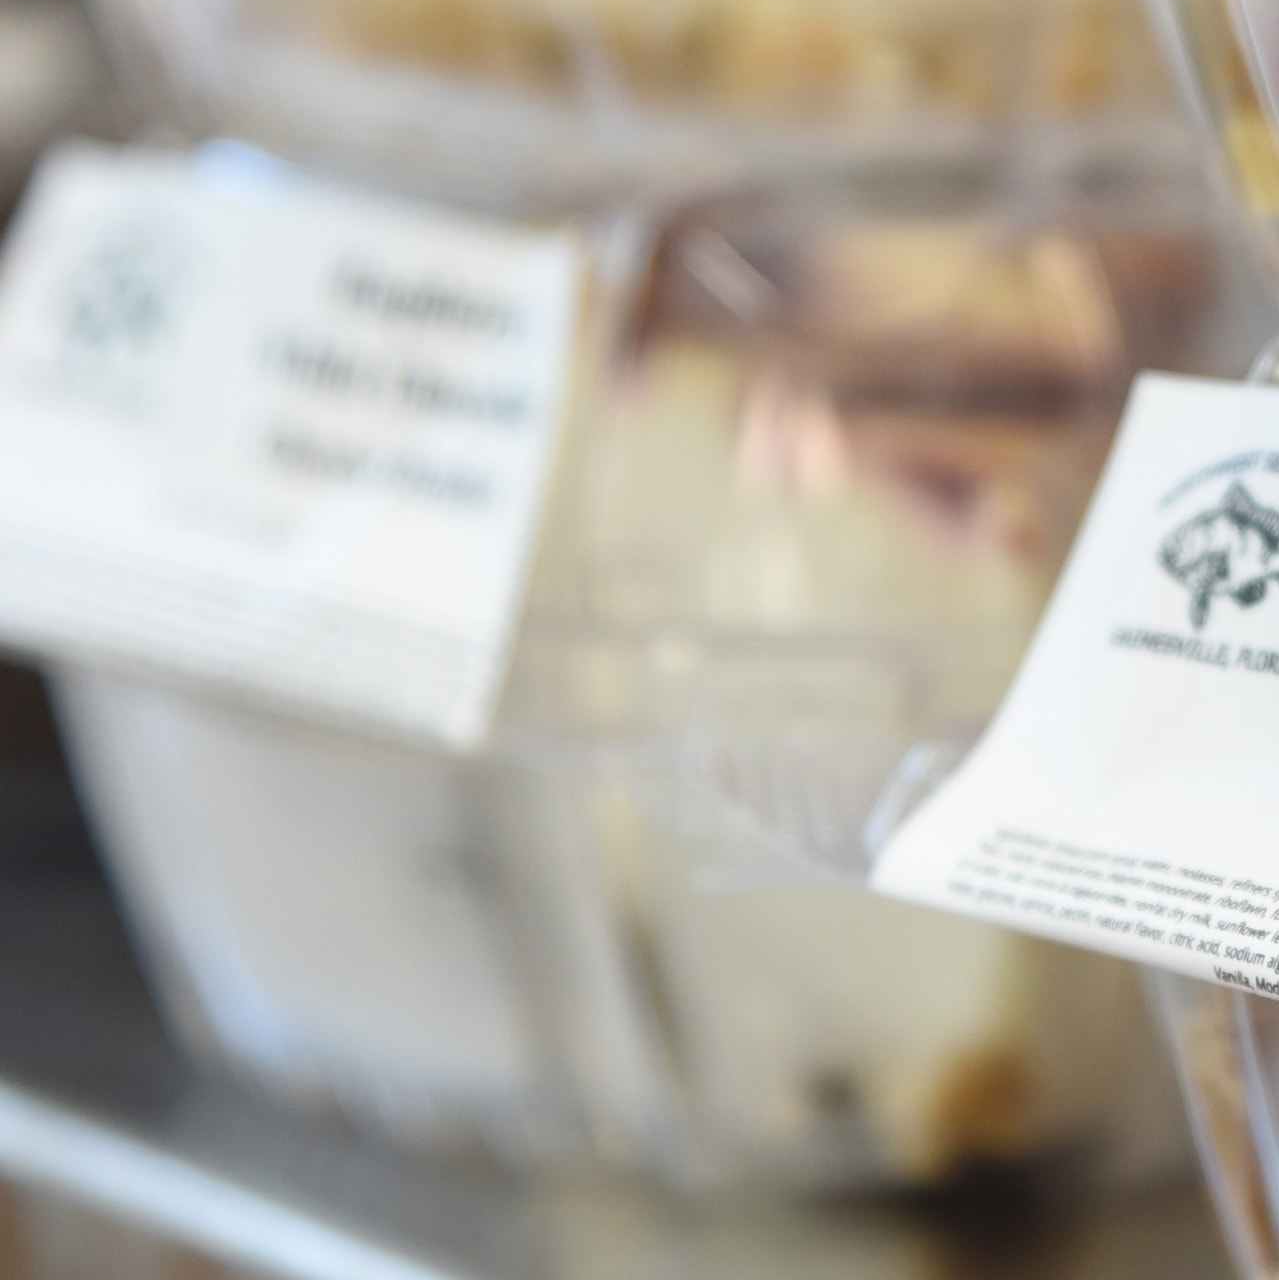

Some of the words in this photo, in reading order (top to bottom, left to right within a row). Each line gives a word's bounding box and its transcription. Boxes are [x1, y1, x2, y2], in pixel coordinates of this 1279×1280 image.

[1227, 878, 1272, 897] refiners
[1214, 918, 1272, 940] sunflower
[1168, 931, 1198, 952] citric
[1196, 937, 1222, 959] acid,
[1224, 944, 1266, 967] sodium
[1213, 964, 1255, 990] Vanilla,
